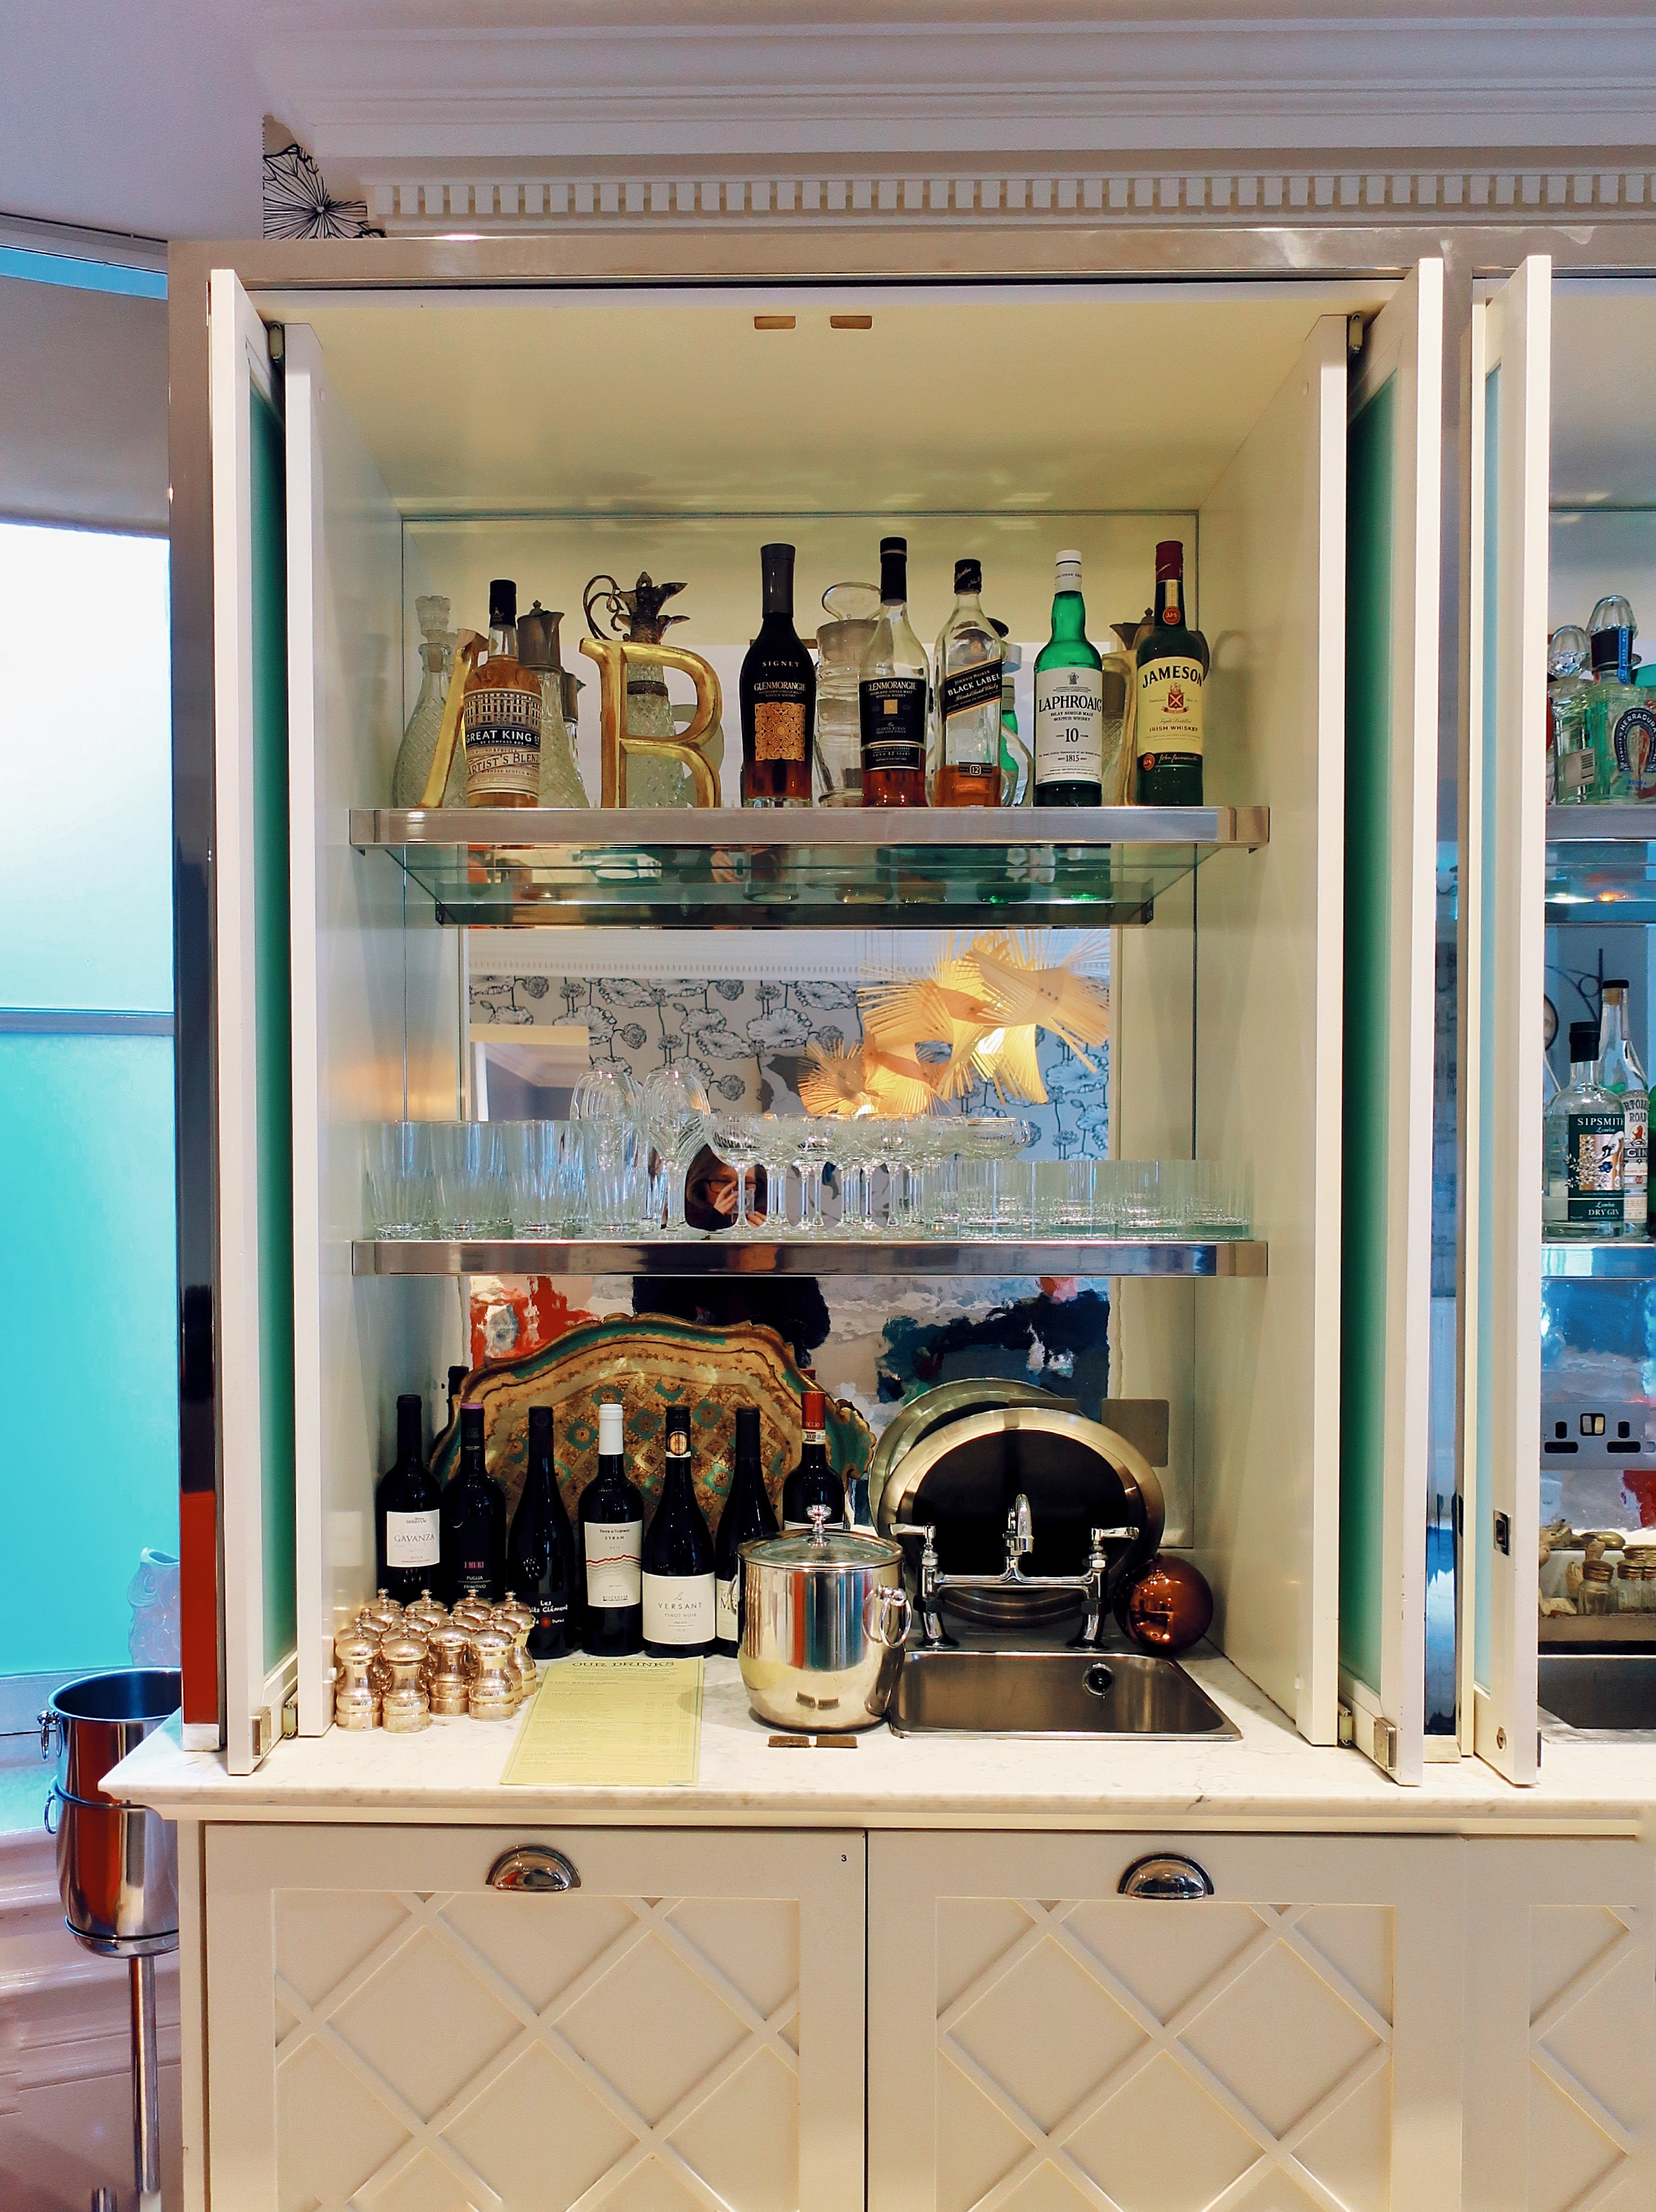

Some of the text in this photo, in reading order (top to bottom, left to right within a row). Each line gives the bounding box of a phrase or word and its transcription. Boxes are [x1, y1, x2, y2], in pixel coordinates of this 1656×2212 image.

[1142, 665, 1202, 689] JAMESON
[754, 681, 806, 692] GLENMORANGIE
[865, 681, 917, 692] GLENMORANGIE
[947, 673, 1001, 697] BLACK LABEL
[1038, 694, 1102, 713] LAPHROAIG
[1620, 713, 1656, 733] HERRADURA
[466, 730, 498, 744] GREAT
[502, 730, 532, 742] KING
[1065, 727, 1079, 743] 10
[1066, 754, 1080, 762] 1815
[469, 754, 509, 776] ARTIST'S
[1629, 1112, 1646, 1122] ROAD
[1627, 1149, 1648, 1157] GIN
[394, 1533, 435, 1542] GAVANZA
[542, 1604, 568, 1613] Clément
[658, 1602, 702, 1610] VERSANT
